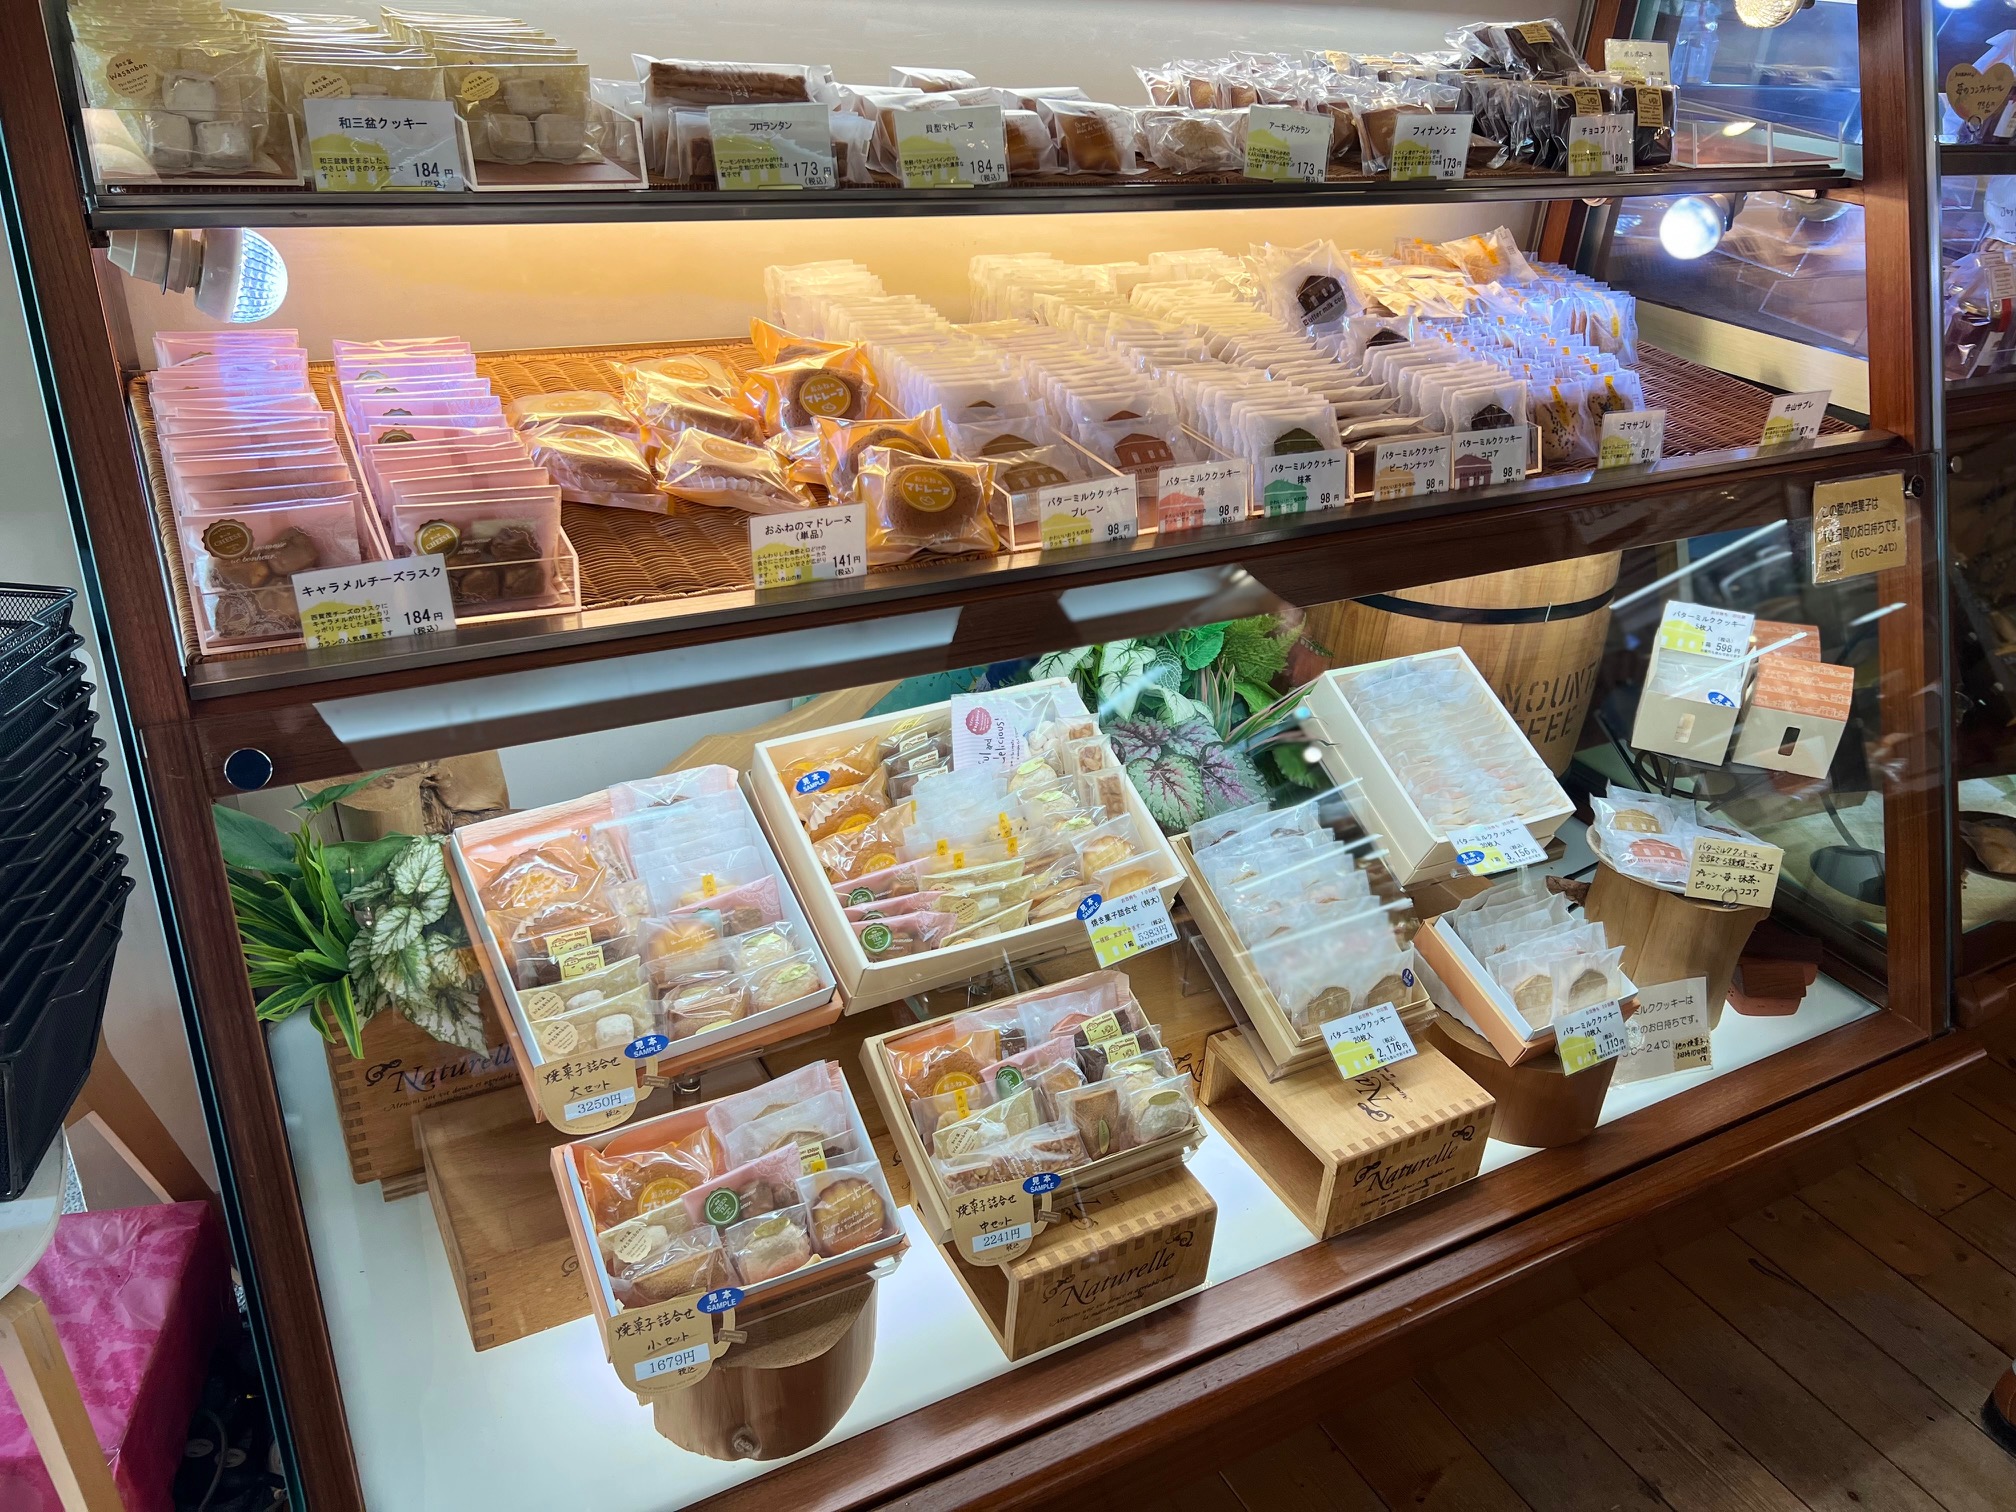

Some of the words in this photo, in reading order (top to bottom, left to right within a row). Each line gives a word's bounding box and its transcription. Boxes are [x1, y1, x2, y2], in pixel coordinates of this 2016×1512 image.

[338, 117, 428, 130] 和三盆クッキー
[749, 121, 793, 132] フロランタン
[925, 121, 975, 134] 貝型マドレーヌ
[1269, 121, 1311, 135] アーモンドカラン
[1413, 125, 1457, 136] フィナンシェ
[1581, 125, 1624, 135] チョコフリアン
[804, 387, 845, 404] マドレーヌ
[1619, 420, 1651, 431] ゴマサブレ
[1459, 434, 1523, 448] バターミルククッキー
[1381, 445, 1447, 460] バターミルククッキー
[1481, 449, 1499, 458] ココア
[1270, 457, 1341, 473] バターミルククッキー
[1388, 459, 1435, 473] ピーカンナッツ
[1165, 469, 1241, 486] バターミルククッキー
[1297, 474, 1312, 484] 抹茶
[904, 482, 951, 496] マドレーヌ
[1047, 486, 1129, 507] バターミルククッキー
[1071, 505, 1104, 518] プレーン
[765, 515, 852, 536] おふねのマドレーヌ
[213, 532, 242, 547] CHEESE
[425, 533, 452, 550] CHEESE
[302, 566, 441, 597] キャラメルチーズラスク
[1672, 610, 1746, 627] バターミルククッキー
[1694, 624, 1714, 632] 5枚入
[801, 772, 821, 786] 見本
[802, 777, 826, 792] SAMPLE
[1456, 827, 1519, 845] バターミルククッキー
[1079, 897, 1095, 913] 見本
[1082, 901, 1100, 920] SAMPLE
[1330, 1016, 1392, 1041] バターミルククッキー
[1563, 1011, 1619, 1036] バターミルククッキー
[633, 1044, 662, 1058] SAMPLE
[635, 1036, 658, 1050] 見本
[543, 1057, 622, 1086] 焼菓子詰合せ
[569, 1079, 611, 1099] 大セット
[577, 1092, 622, 1114] 3250円
[1366, 1140, 1459, 1192] Naturelle
[1029, 1182, 1055, 1193] SAMPLE
[1032, 1174, 1052, 1186] 見本
[955, 1194, 1017, 1219] 焼菓子詰合せ
[979, 1216, 1013, 1234] 中セット
[983, 1227, 1021, 1247] 2241円
[1060, 1247, 1175, 1308] Naturelle
[708, 1289, 732, 1305] 見本
[706, 1298, 737, 1313] SAMPLE
[615, 1308, 696, 1341] 焼菓子詰合せ
[647, 1331, 690, 1351] 小セット
[649, 1349, 695, 1374] 1679円
